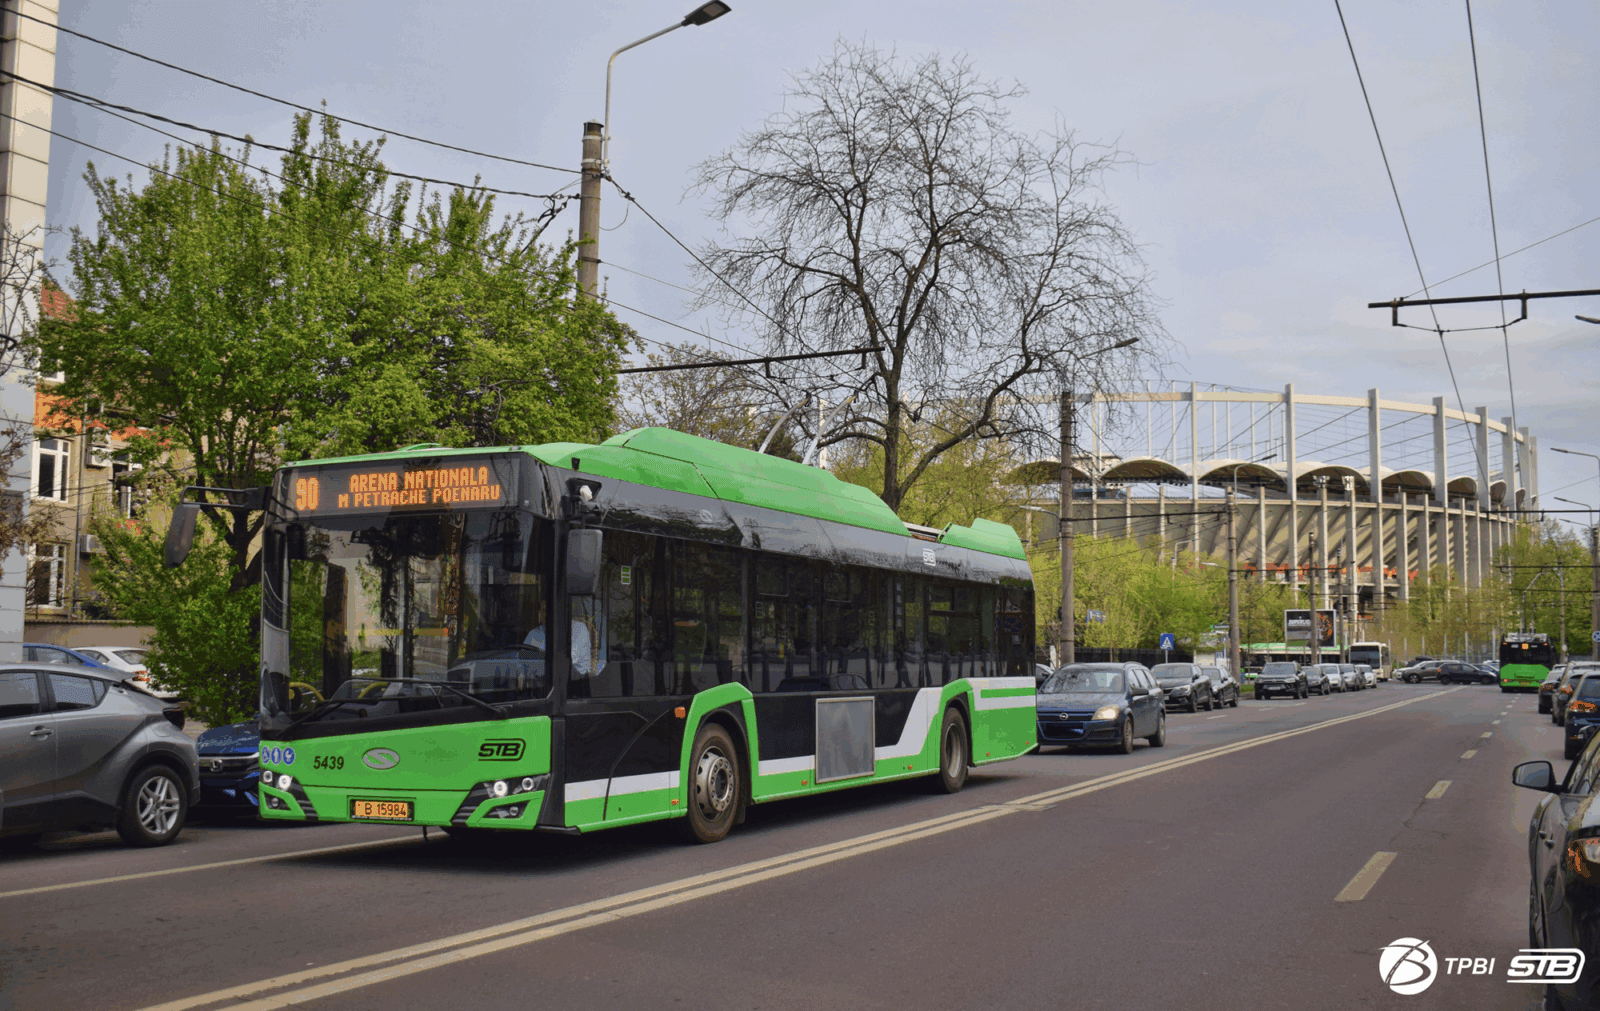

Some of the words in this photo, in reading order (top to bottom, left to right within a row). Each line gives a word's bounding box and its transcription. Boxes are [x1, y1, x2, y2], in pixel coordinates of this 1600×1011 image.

[350, 471, 398, 493] ARENA
[404, 466, 489, 490] NATIONALA
[296, 477, 319, 511] 90
[338, 493, 349, 508] M
[354, 489, 427, 507] PETRACHE
[432, 484, 500, 504] POENARU
[478, 741, 522, 758] STB
[313, 755, 345, 770] 5439
[364, 802, 373, 815] B
[377, 802, 407, 817] 15984
